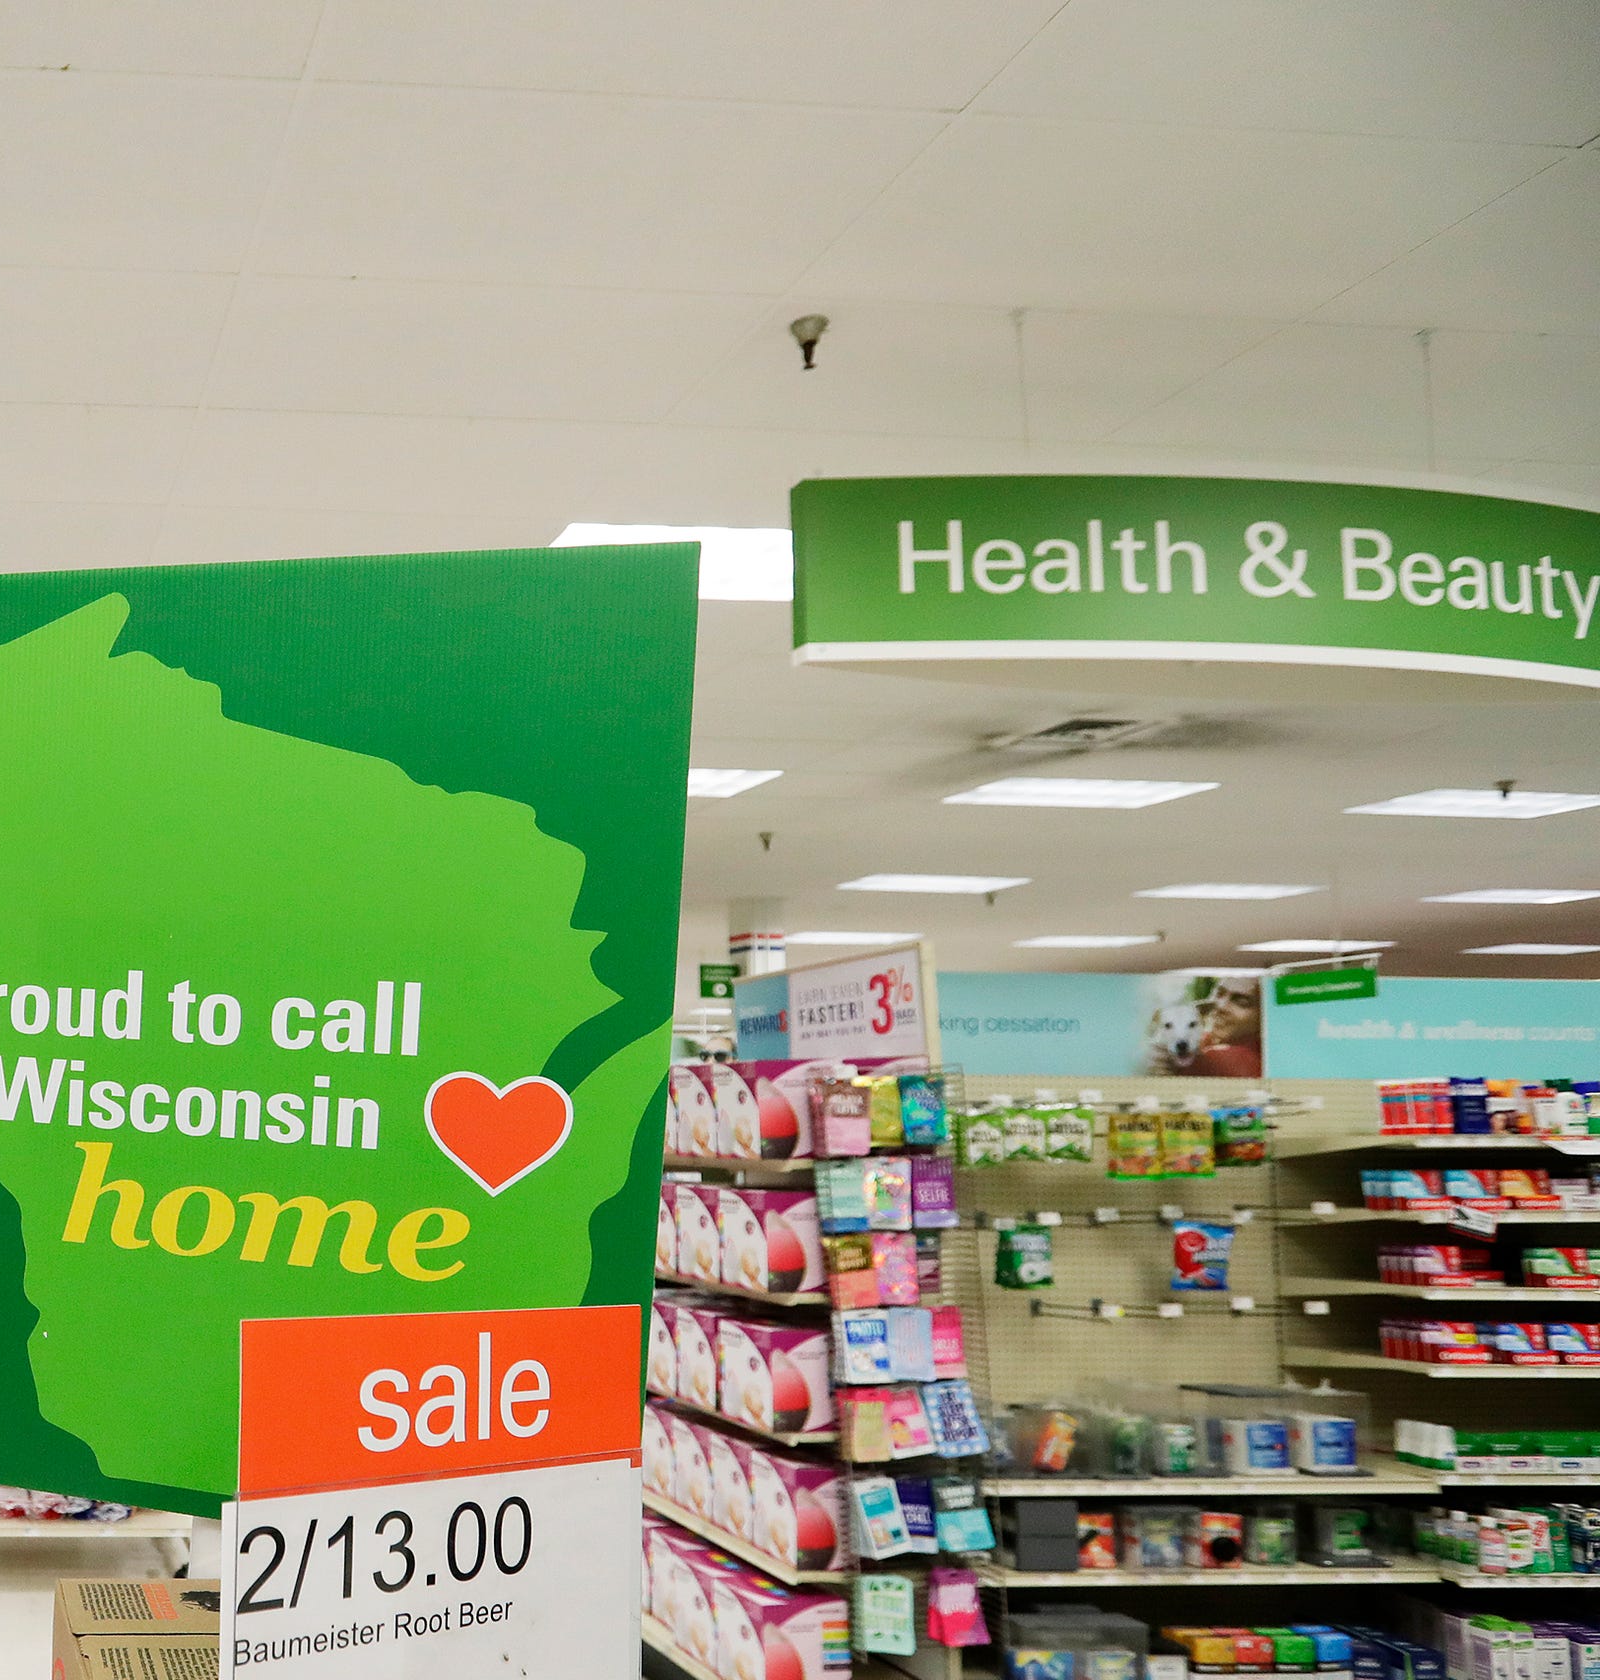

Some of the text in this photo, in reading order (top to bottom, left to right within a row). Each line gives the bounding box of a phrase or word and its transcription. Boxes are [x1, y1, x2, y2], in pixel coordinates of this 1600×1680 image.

[897, 519, 1600, 640] Health & Beauty
[168, 979, 242, 1046] to
[271, 980, 422, 1056] call
[799, 1001, 865, 1027] FASTER!
[62, 1141, 470, 1282] home
[357, 1331, 551, 1453] sale
[237, 1496, 532, 1615] 2/13.00
[234, 1618, 385, 1667] Baumeister
[394, 1607, 450, 1642] Root
[459, 1600, 513, 1628] Beer
